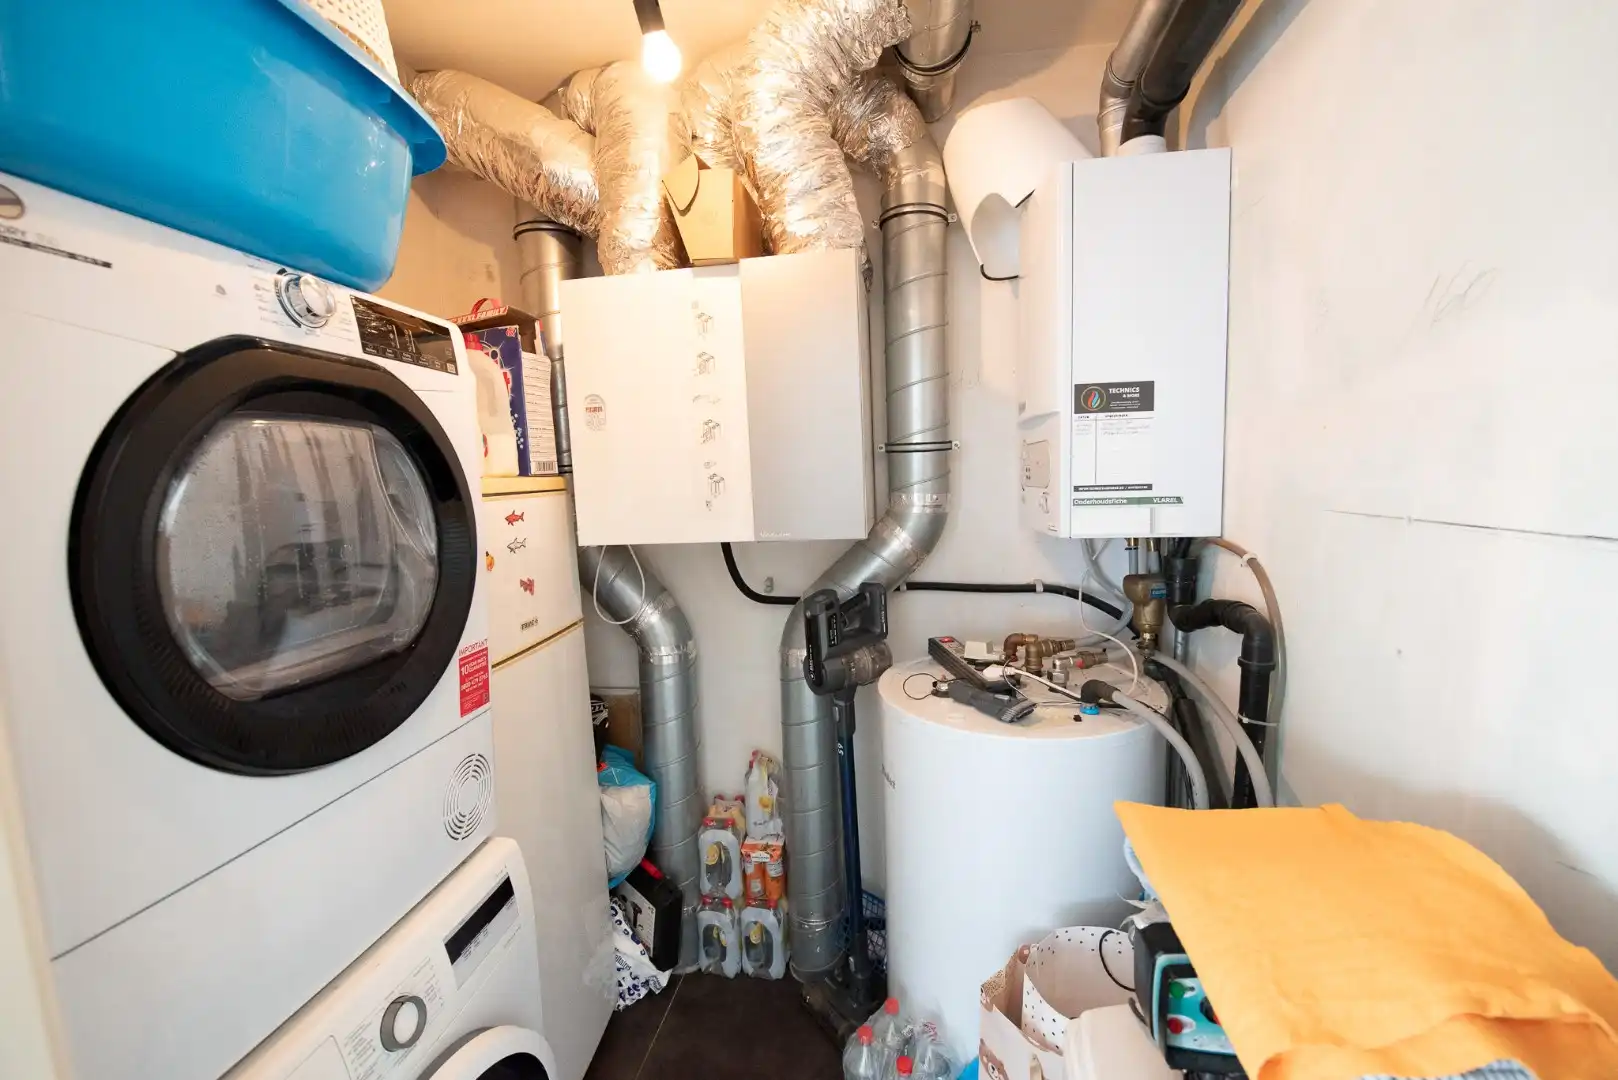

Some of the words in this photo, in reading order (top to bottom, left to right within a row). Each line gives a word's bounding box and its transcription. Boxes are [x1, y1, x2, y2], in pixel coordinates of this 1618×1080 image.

[1108, 386, 1140, 394] TECHNICS
[459, 638, 488, 657] IMPORTANT
[460, 664, 469, 676] 10
